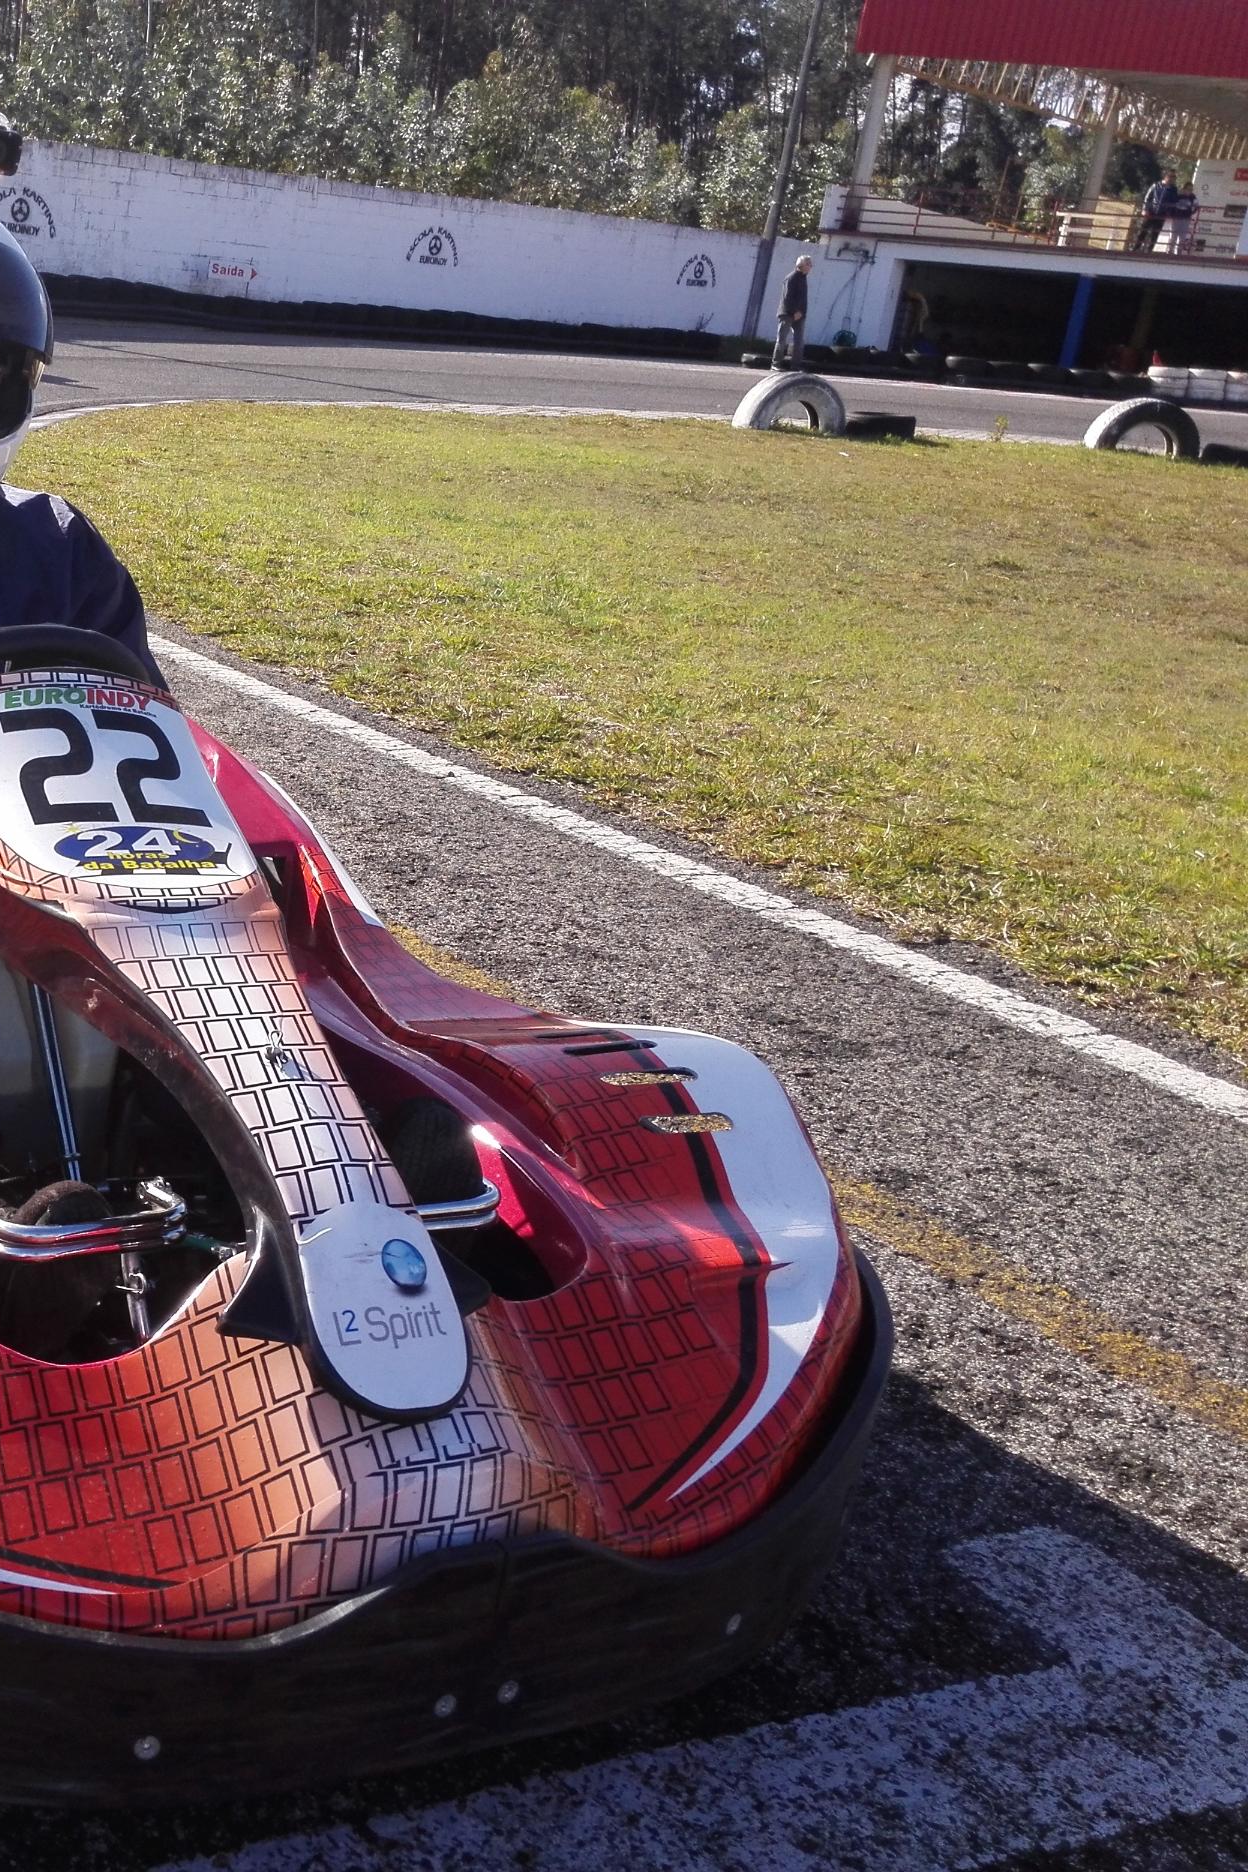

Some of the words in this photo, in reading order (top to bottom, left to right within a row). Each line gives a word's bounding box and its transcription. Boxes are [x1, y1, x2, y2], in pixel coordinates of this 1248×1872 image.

[22, 187, 56, 239] KARTING
[4, 687, 150, 711] EUROINDY
[77, 829, 181, 858] 24
[106, 850, 171, 861] horas
[82, 860, 115, 871] da
[120, 859, 218, 870] Batalha
